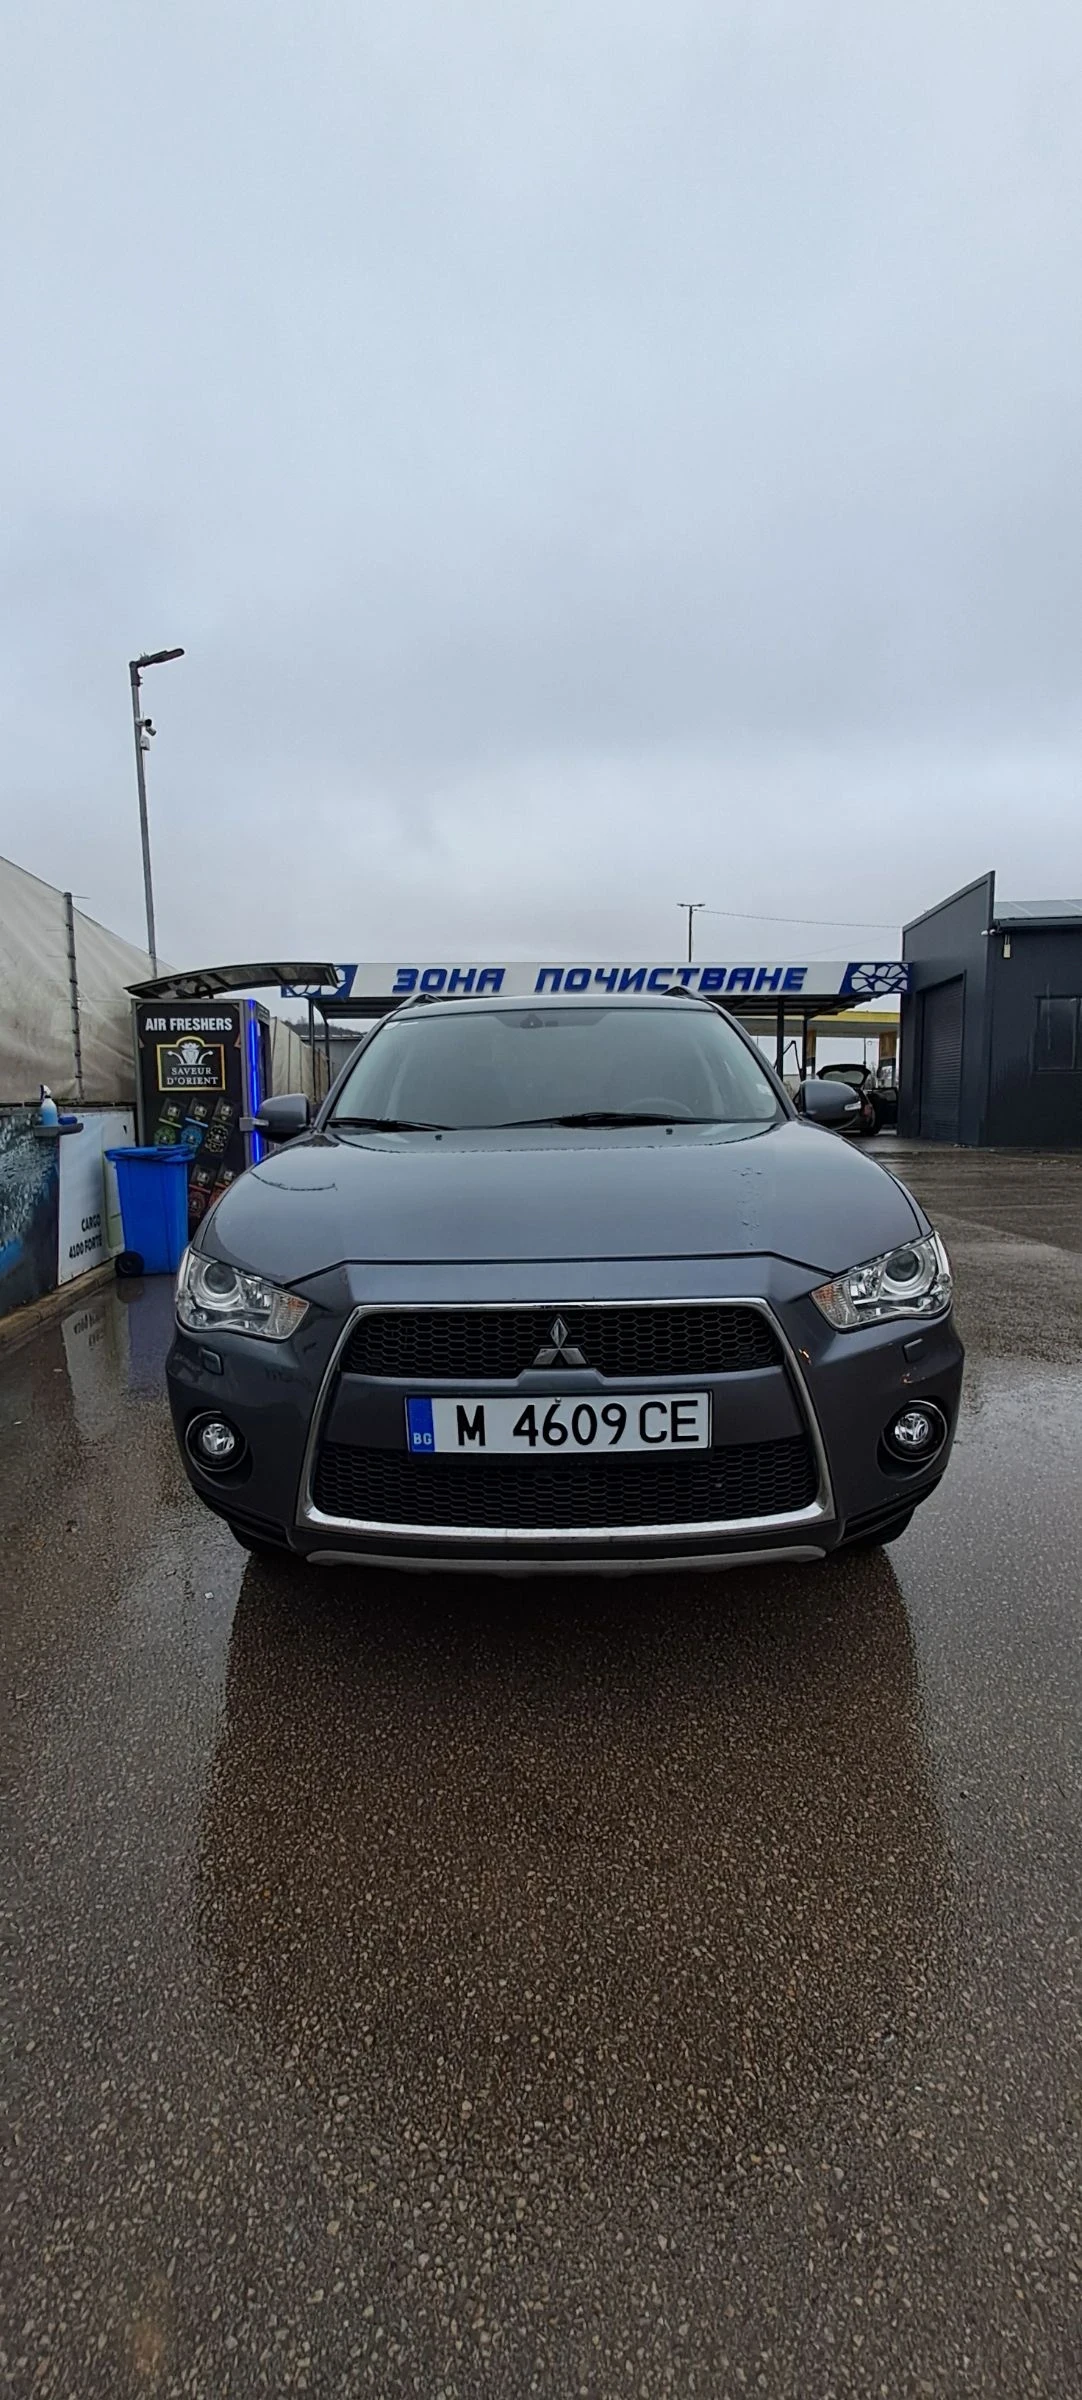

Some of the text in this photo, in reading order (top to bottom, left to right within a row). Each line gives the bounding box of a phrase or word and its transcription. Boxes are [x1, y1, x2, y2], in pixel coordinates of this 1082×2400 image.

[392, 967, 808, 993] ЗОНА ПОЧИСТВАНЕ
[145, 1017, 233, 1031] AIR FRESHERS
[171, 1067, 212, 1076] SAVEUR
[166, 1076, 218, 1086] D'ORIENT
[81, 1213, 102, 1233] CARGO
[69, 1241, 84, 1259] 4100
[413, 1400, 699, 1447] BG M 4609 CE
